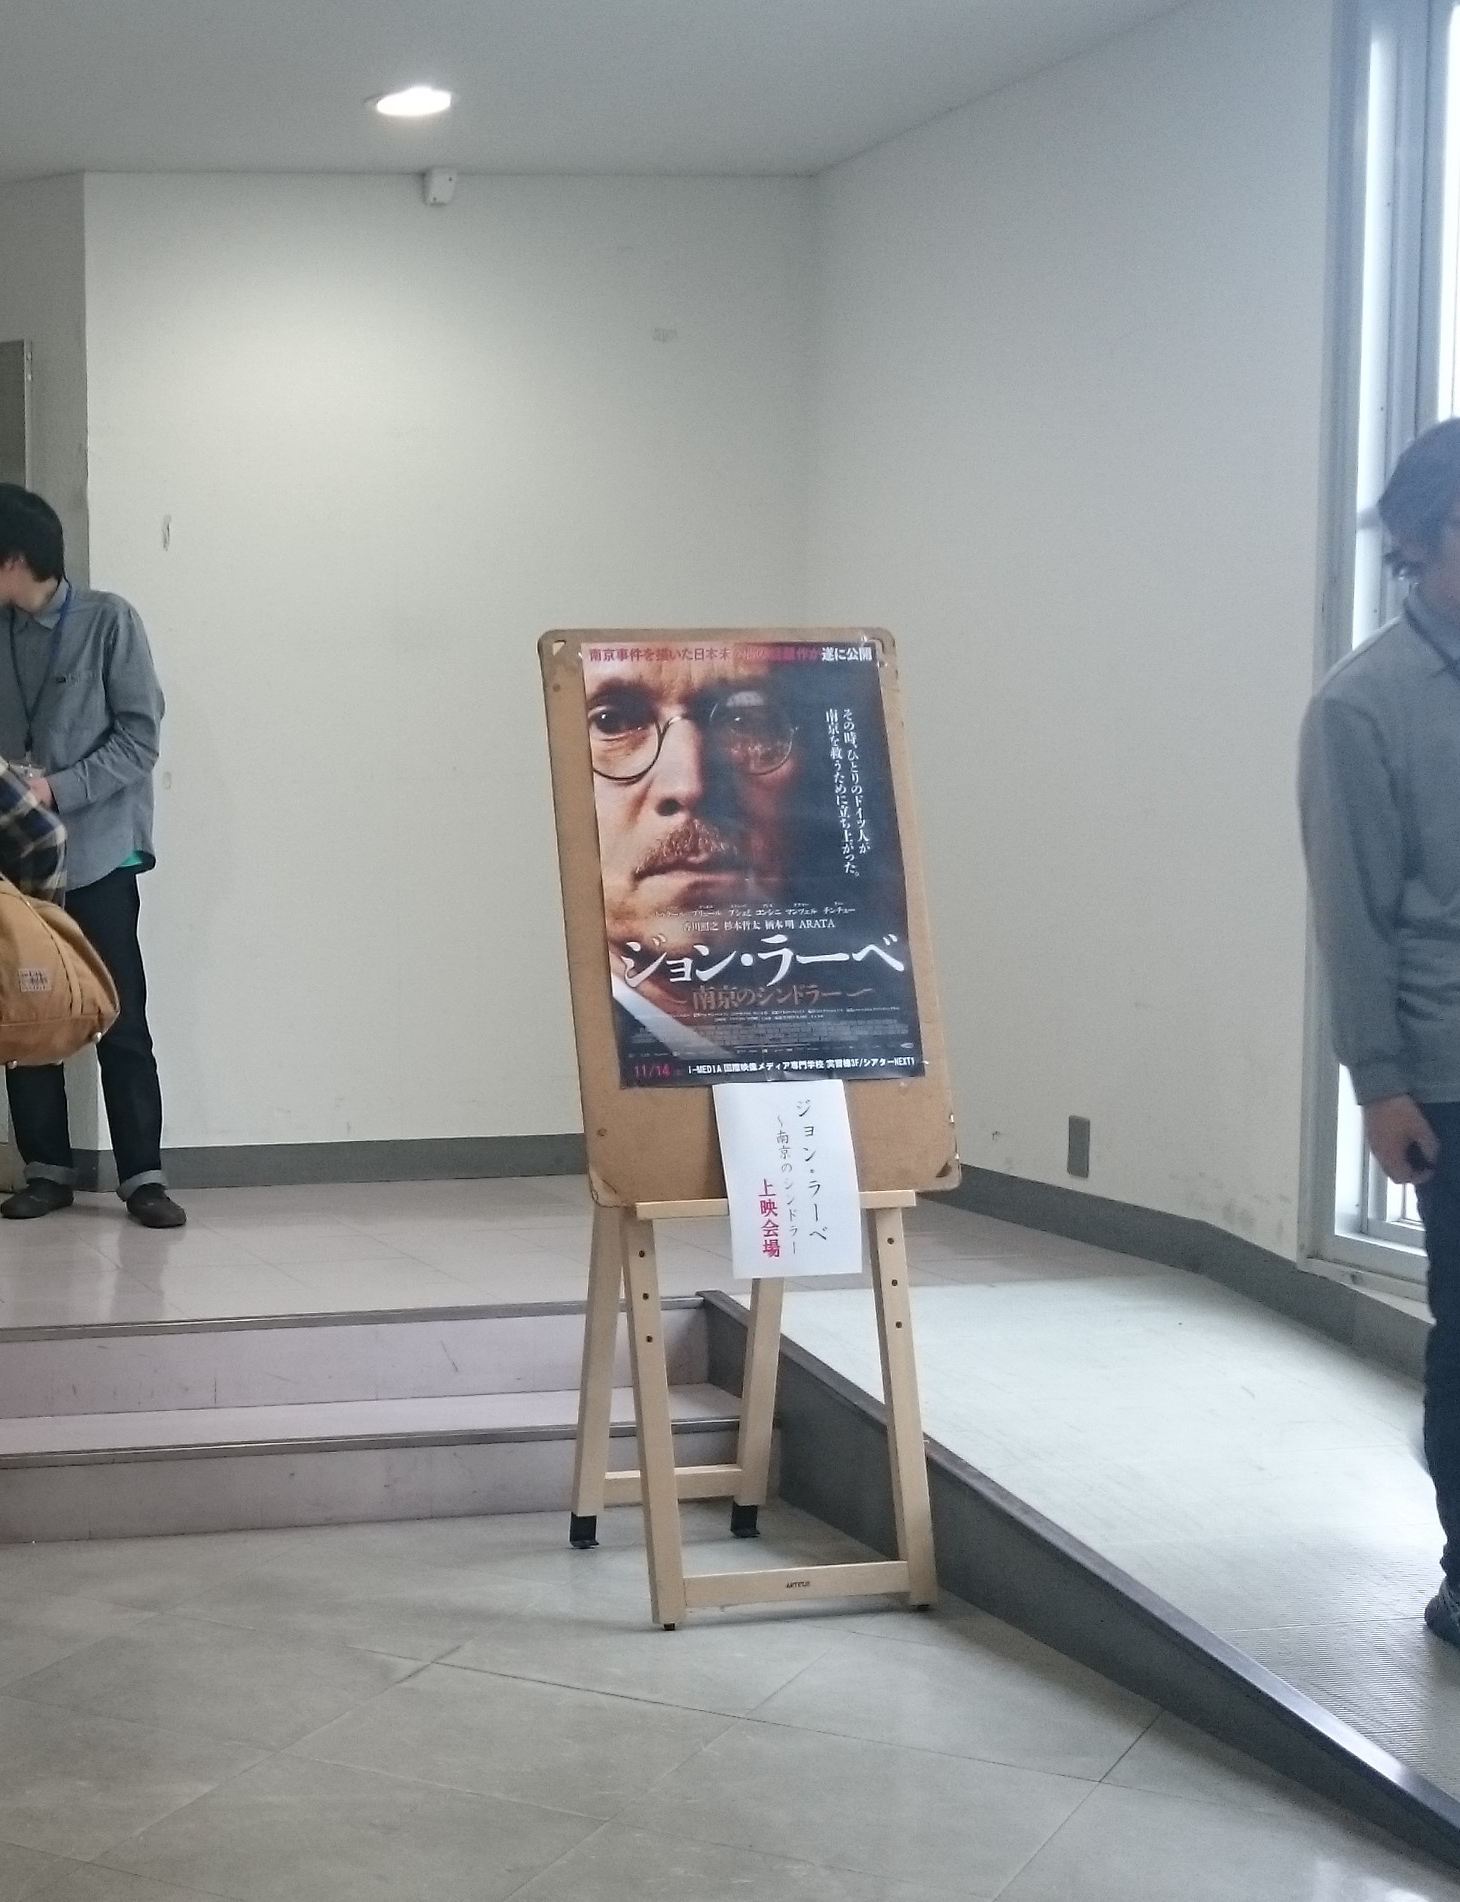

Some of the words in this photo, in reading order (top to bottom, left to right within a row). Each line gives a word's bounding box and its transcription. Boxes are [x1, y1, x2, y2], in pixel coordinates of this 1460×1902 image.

[826, 708, 860, 878] 南京を救うために立ち上がった。
[843, 708, 871, 854] その時、ひとりのドイツ人が
[621, 933, 905, 988] ジョン・ラーベ
[798, 918, 836, 929] ARATA
[633, 1063, 671, 1078] 11/14
[688, 1061, 722, 1075] I-MEDIA
[796, 1099, 828, 1241] ジョン・ラーベ
[758, 1178, 781, 1258] 上映会場
